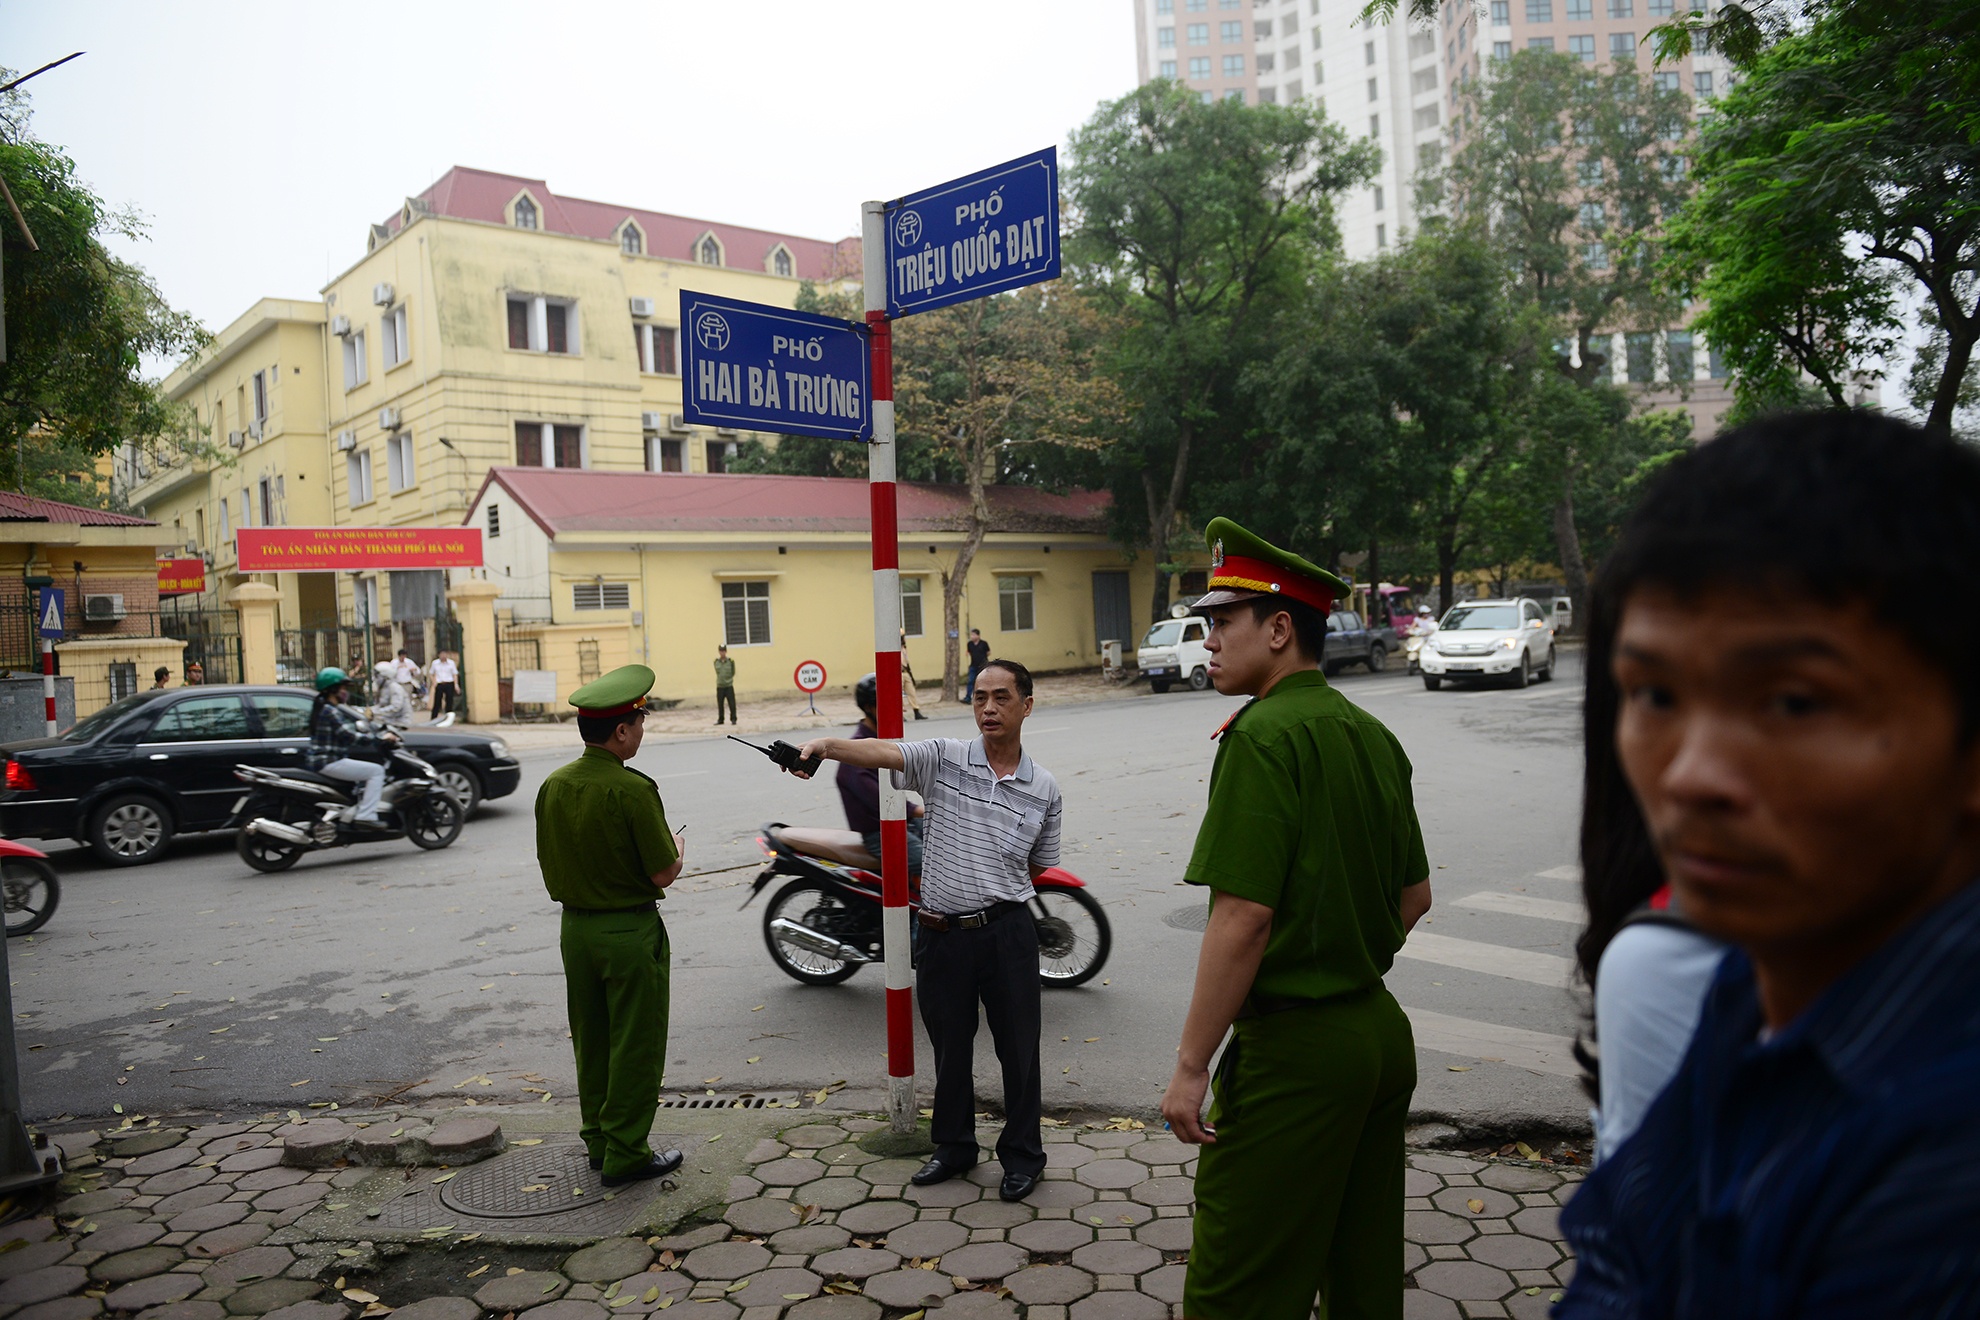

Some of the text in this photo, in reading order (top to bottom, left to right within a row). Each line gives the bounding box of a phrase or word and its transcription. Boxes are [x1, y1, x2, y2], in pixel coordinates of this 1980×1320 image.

[955, 184, 1005, 226] PHỐ
[896, 215, 1045, 296] TRIỆU QUỐC ĐẠT
[773, 335, 825, 362] PHỐ
[699, 359, 860, 419] HAI BÀ TRƯNG
[261, 540, 465, 556] TÒA ÁN NHÂN DÂN THÀNH PHỐ HÀ NỘI
